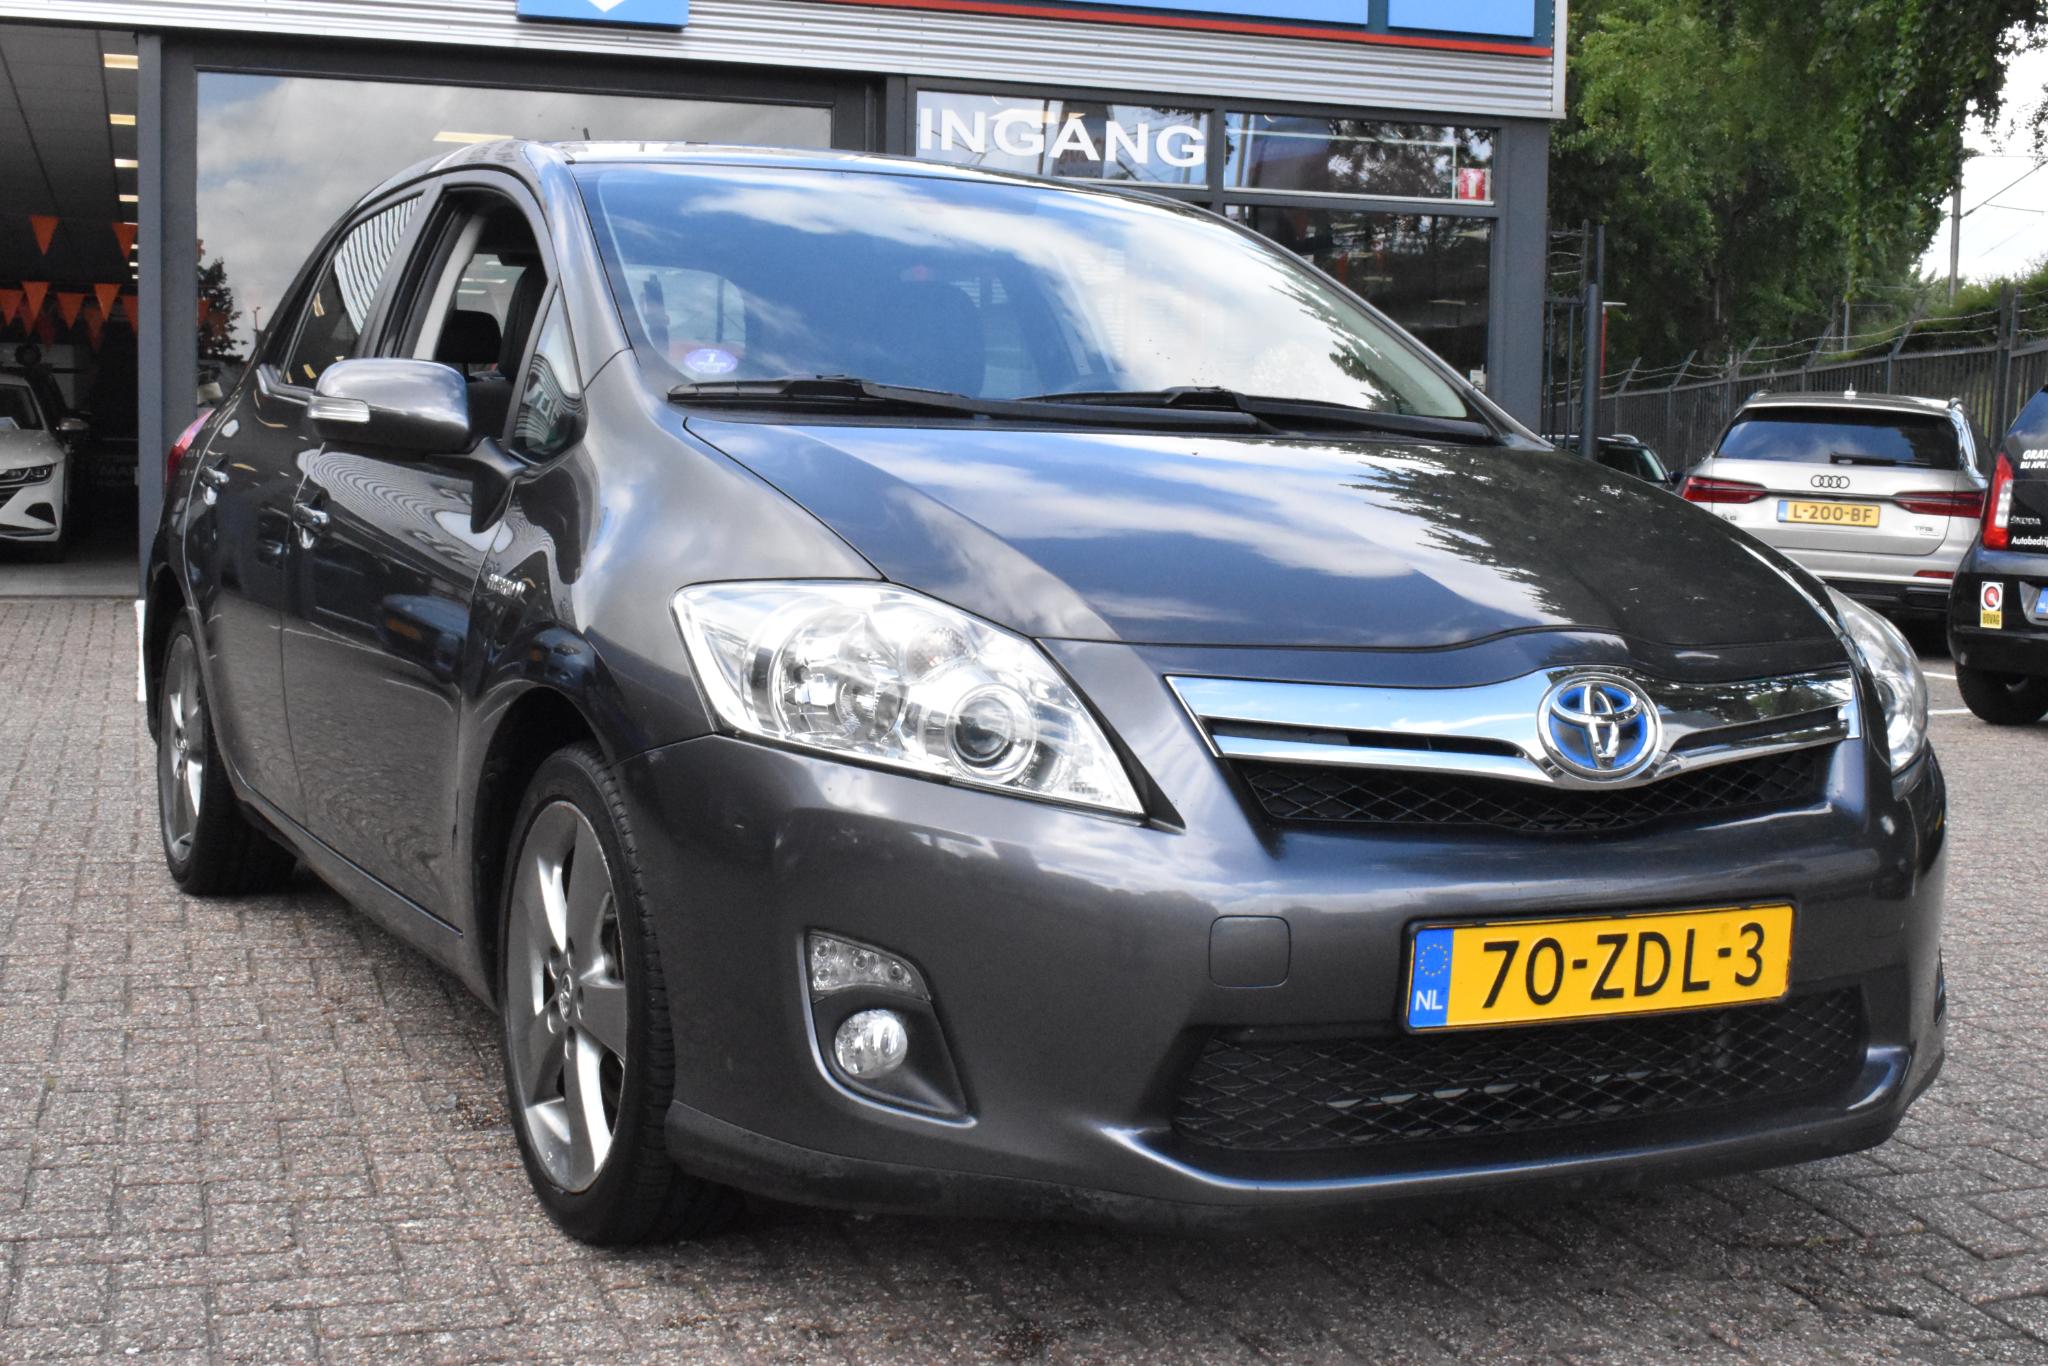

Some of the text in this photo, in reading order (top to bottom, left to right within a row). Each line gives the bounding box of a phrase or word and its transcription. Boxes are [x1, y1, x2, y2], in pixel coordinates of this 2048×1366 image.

[919, 108, 1206, 168] INGANG
[2023, 450, 2048, 460] GRAT
[1792, 505, 1873, 523] L-200-BF
[1482, 922, 1765, 1009] 70-ZDL-3
[1415, 990, 1443, 1011] NL
